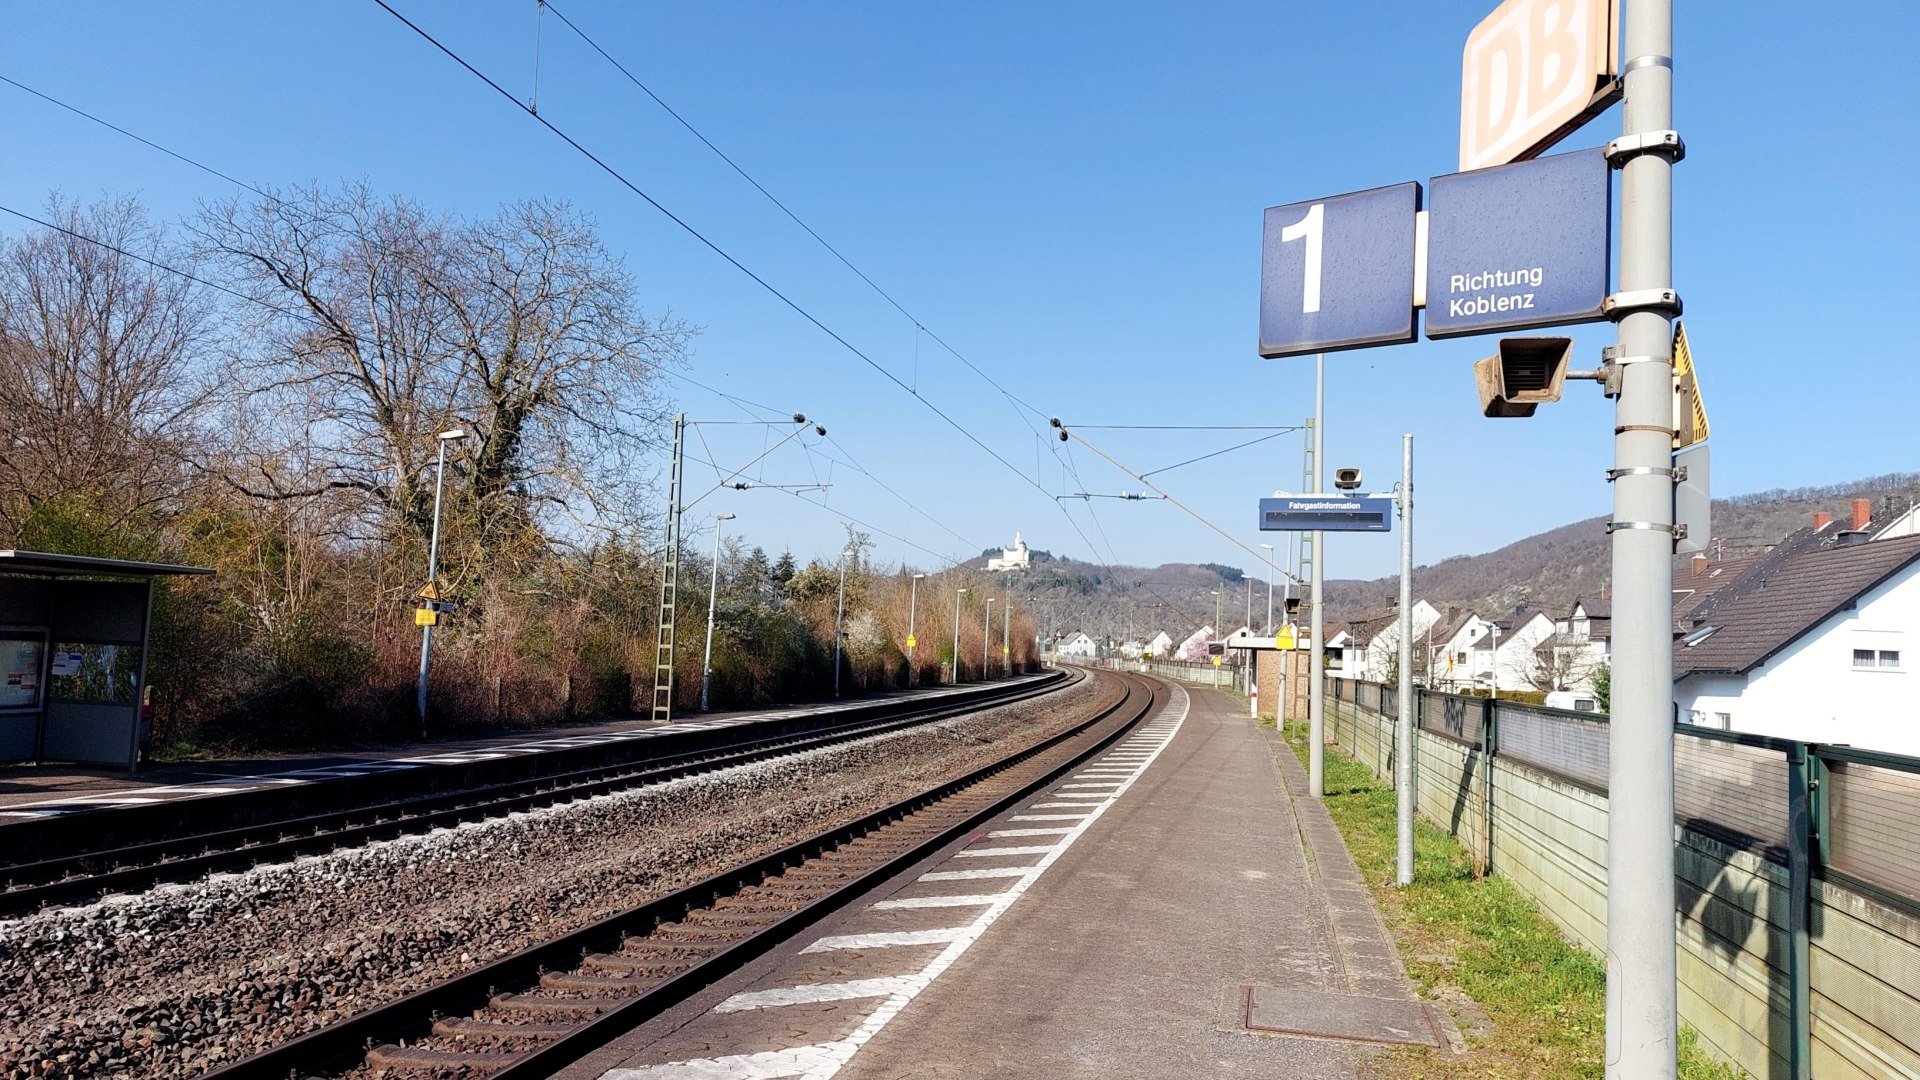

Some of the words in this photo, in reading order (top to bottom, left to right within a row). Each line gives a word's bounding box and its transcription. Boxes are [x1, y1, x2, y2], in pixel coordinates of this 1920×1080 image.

[1476, 0, 1577, 155] DB
[1281, 203, 1325, 314] 1
[1450, 267, 1543, 294] Richtung
[1449, 293, 1535, 318] Koblenz
[1288, 501, 1361, 511] Fahrgastinformation
